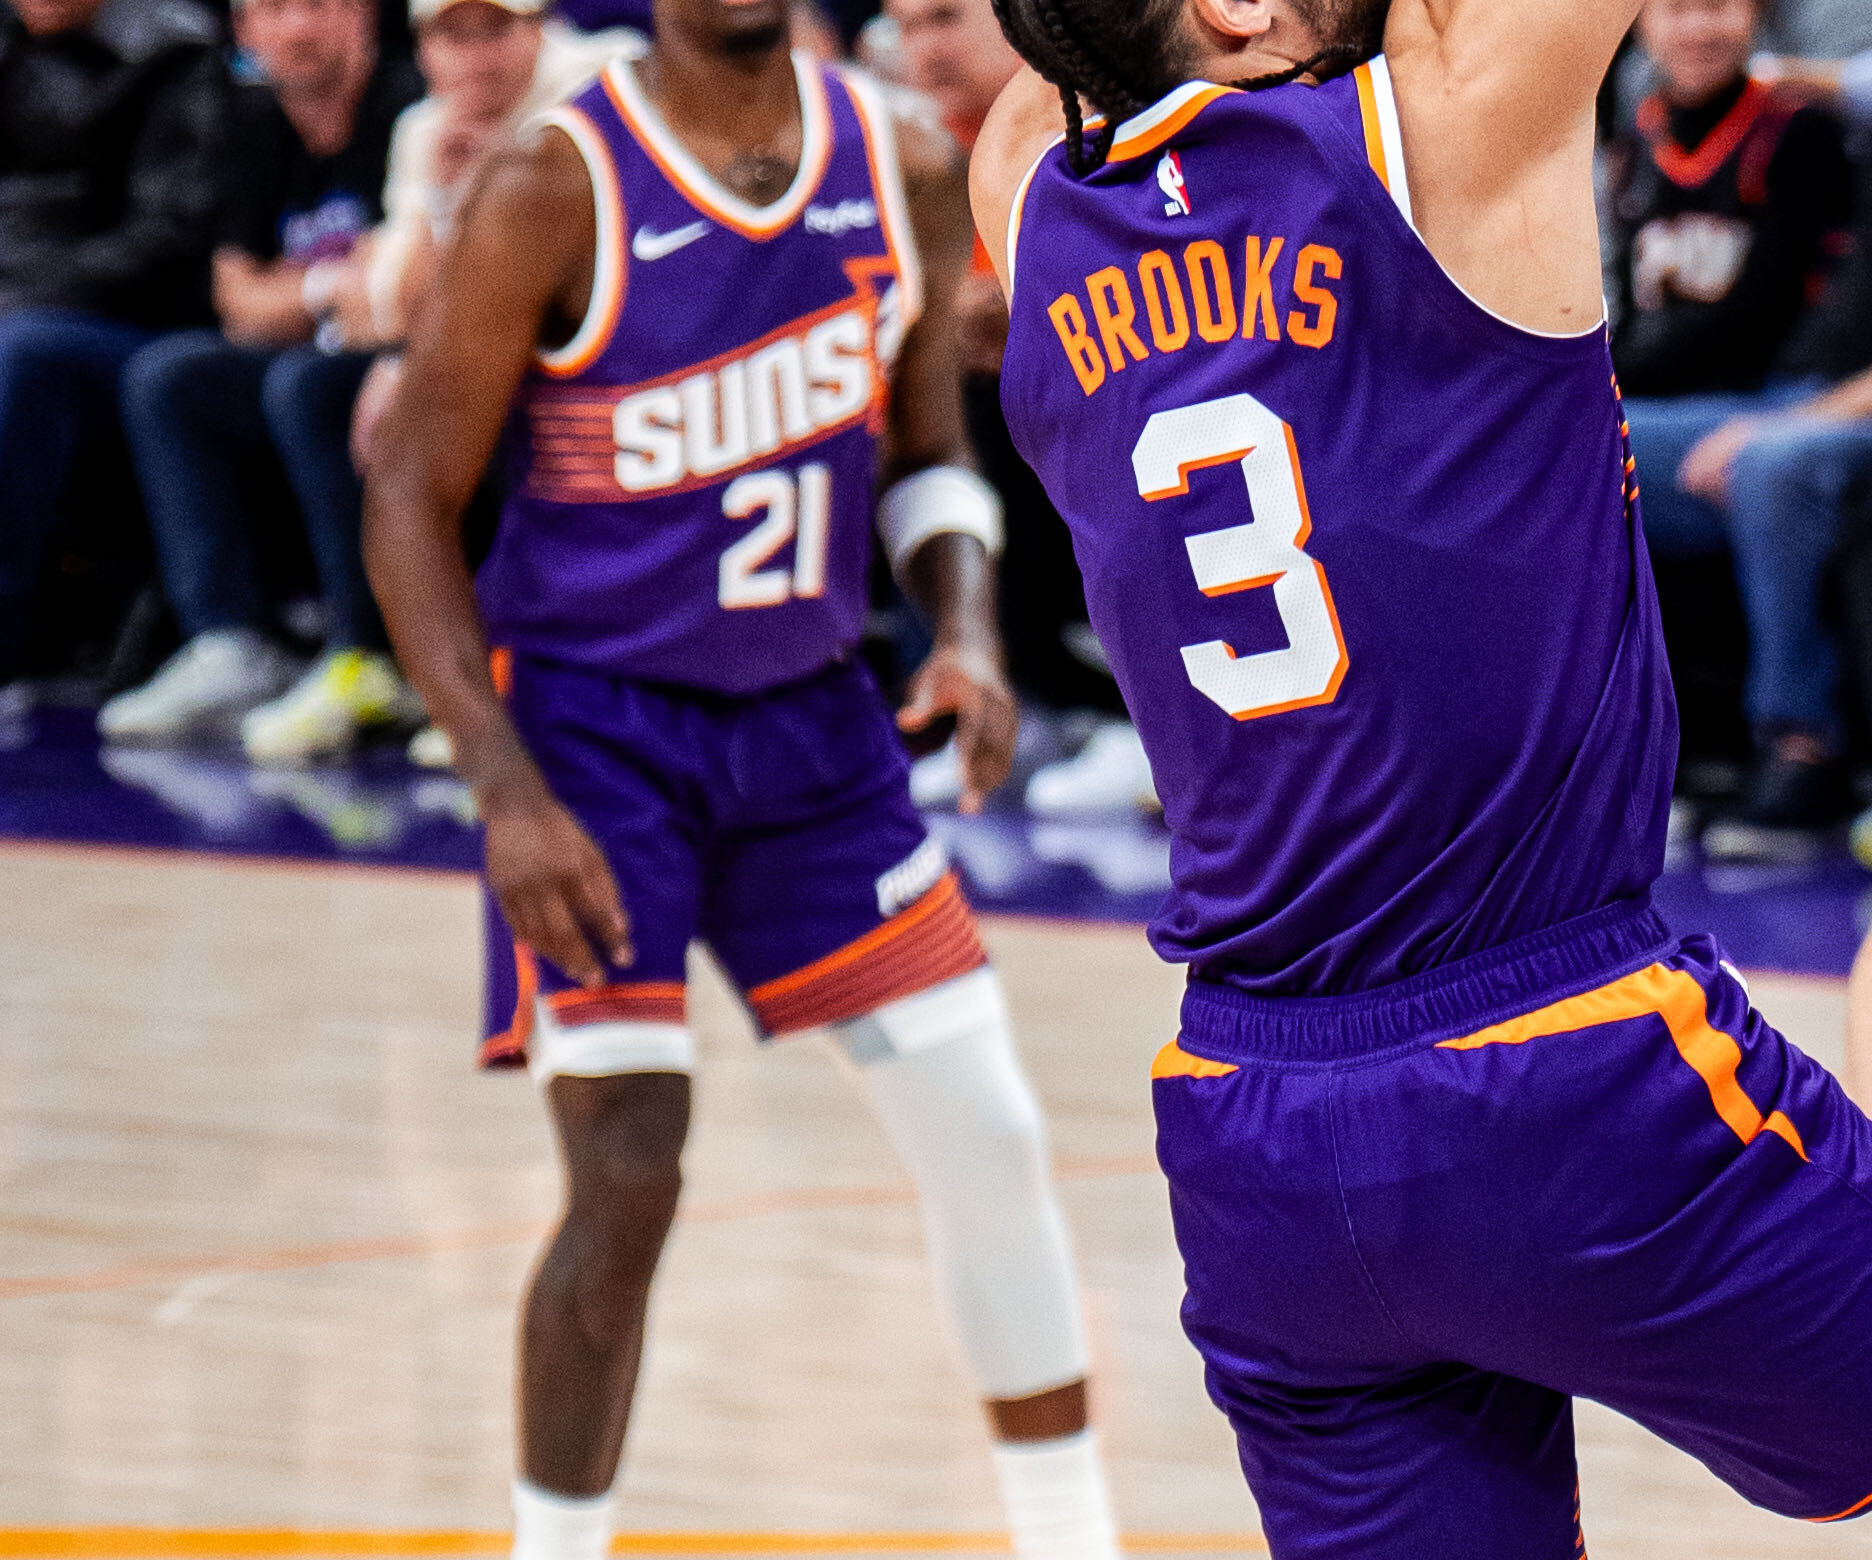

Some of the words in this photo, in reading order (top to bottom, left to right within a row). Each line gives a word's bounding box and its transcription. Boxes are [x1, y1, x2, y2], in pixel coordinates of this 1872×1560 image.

[612, 310, 871, 492] SUNS
[1047, 235, 1343, 396] BROOKS
[718, 460, 832, 611] 21
[1131, 392, 1349, 722] 3
